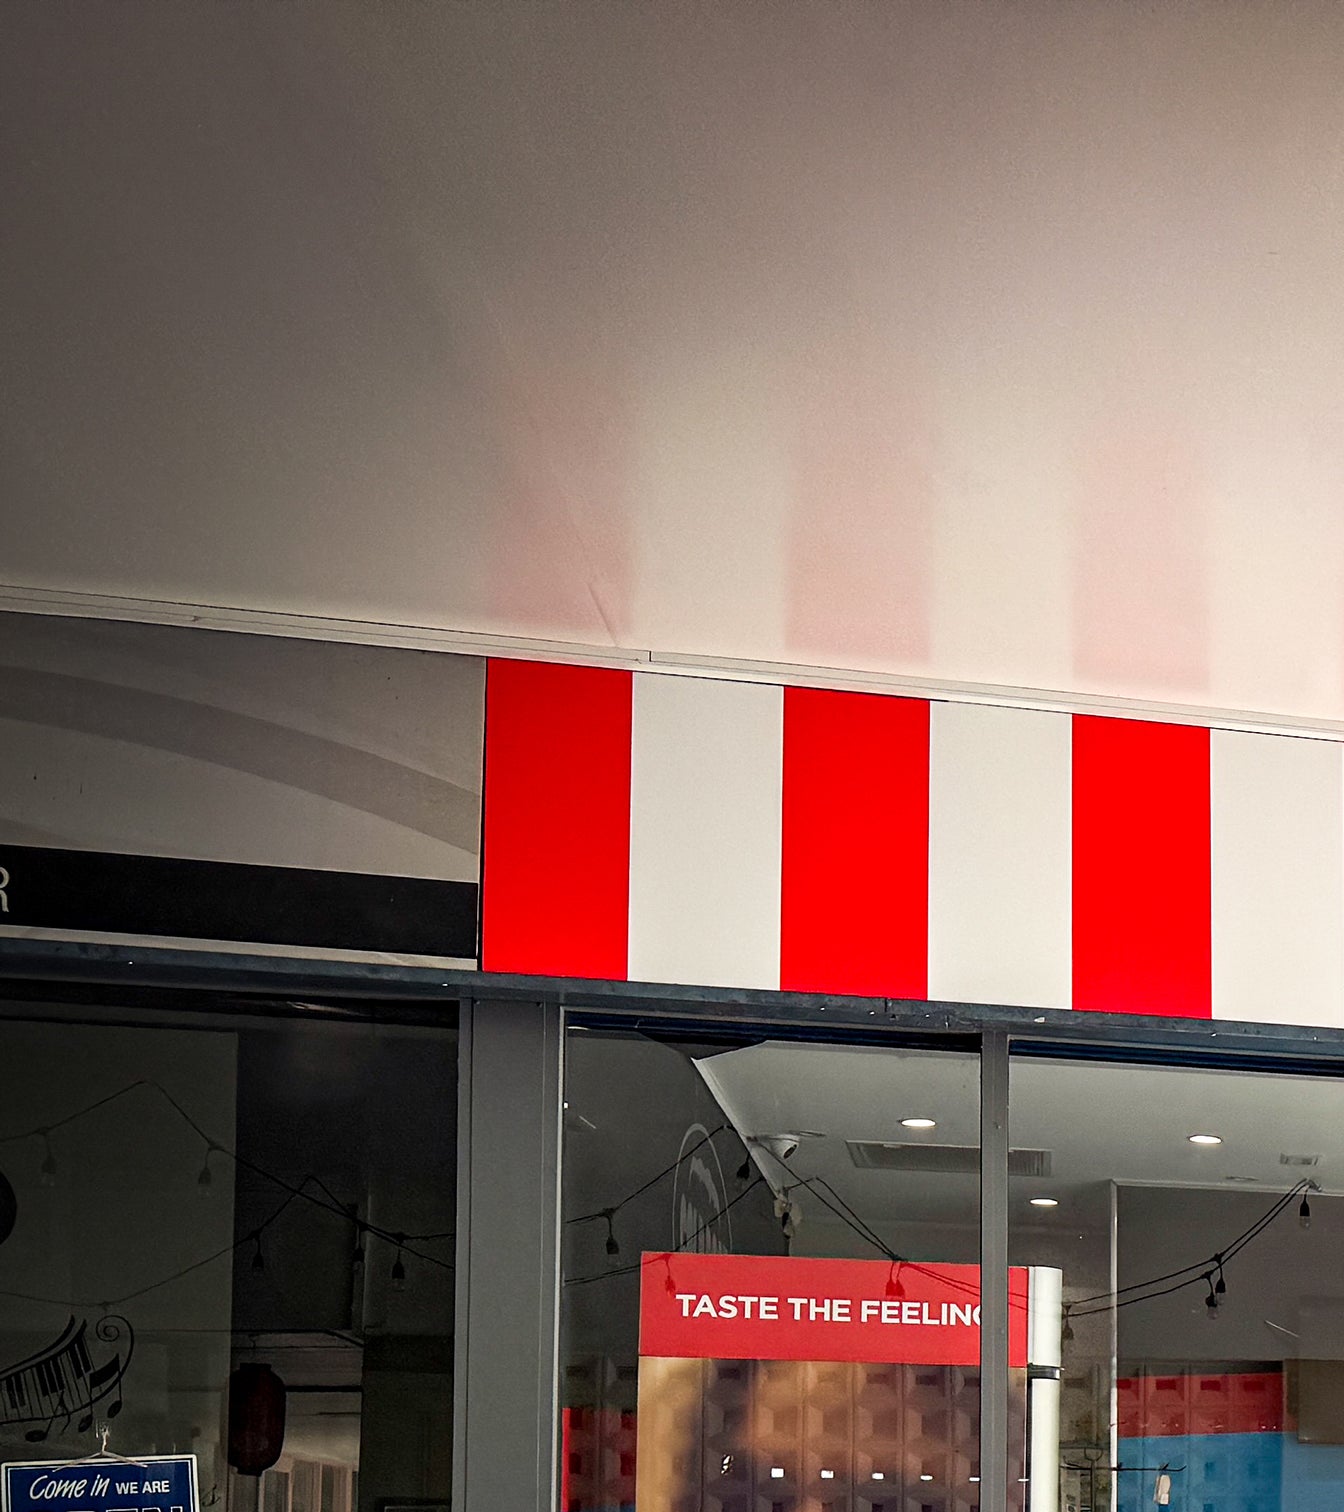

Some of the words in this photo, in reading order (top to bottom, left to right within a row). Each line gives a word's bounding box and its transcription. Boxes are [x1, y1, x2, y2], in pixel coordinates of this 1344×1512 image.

[675, 1293, 779, 1320] TASTE
[787, 1297, 851, 1322] THE
[29, 1474, 89, 1500] Come
[90, 1474, 110, 1497] in
[116, 1481, 139, 1495] WE
[142, 1480, 170, 1494] ARE
